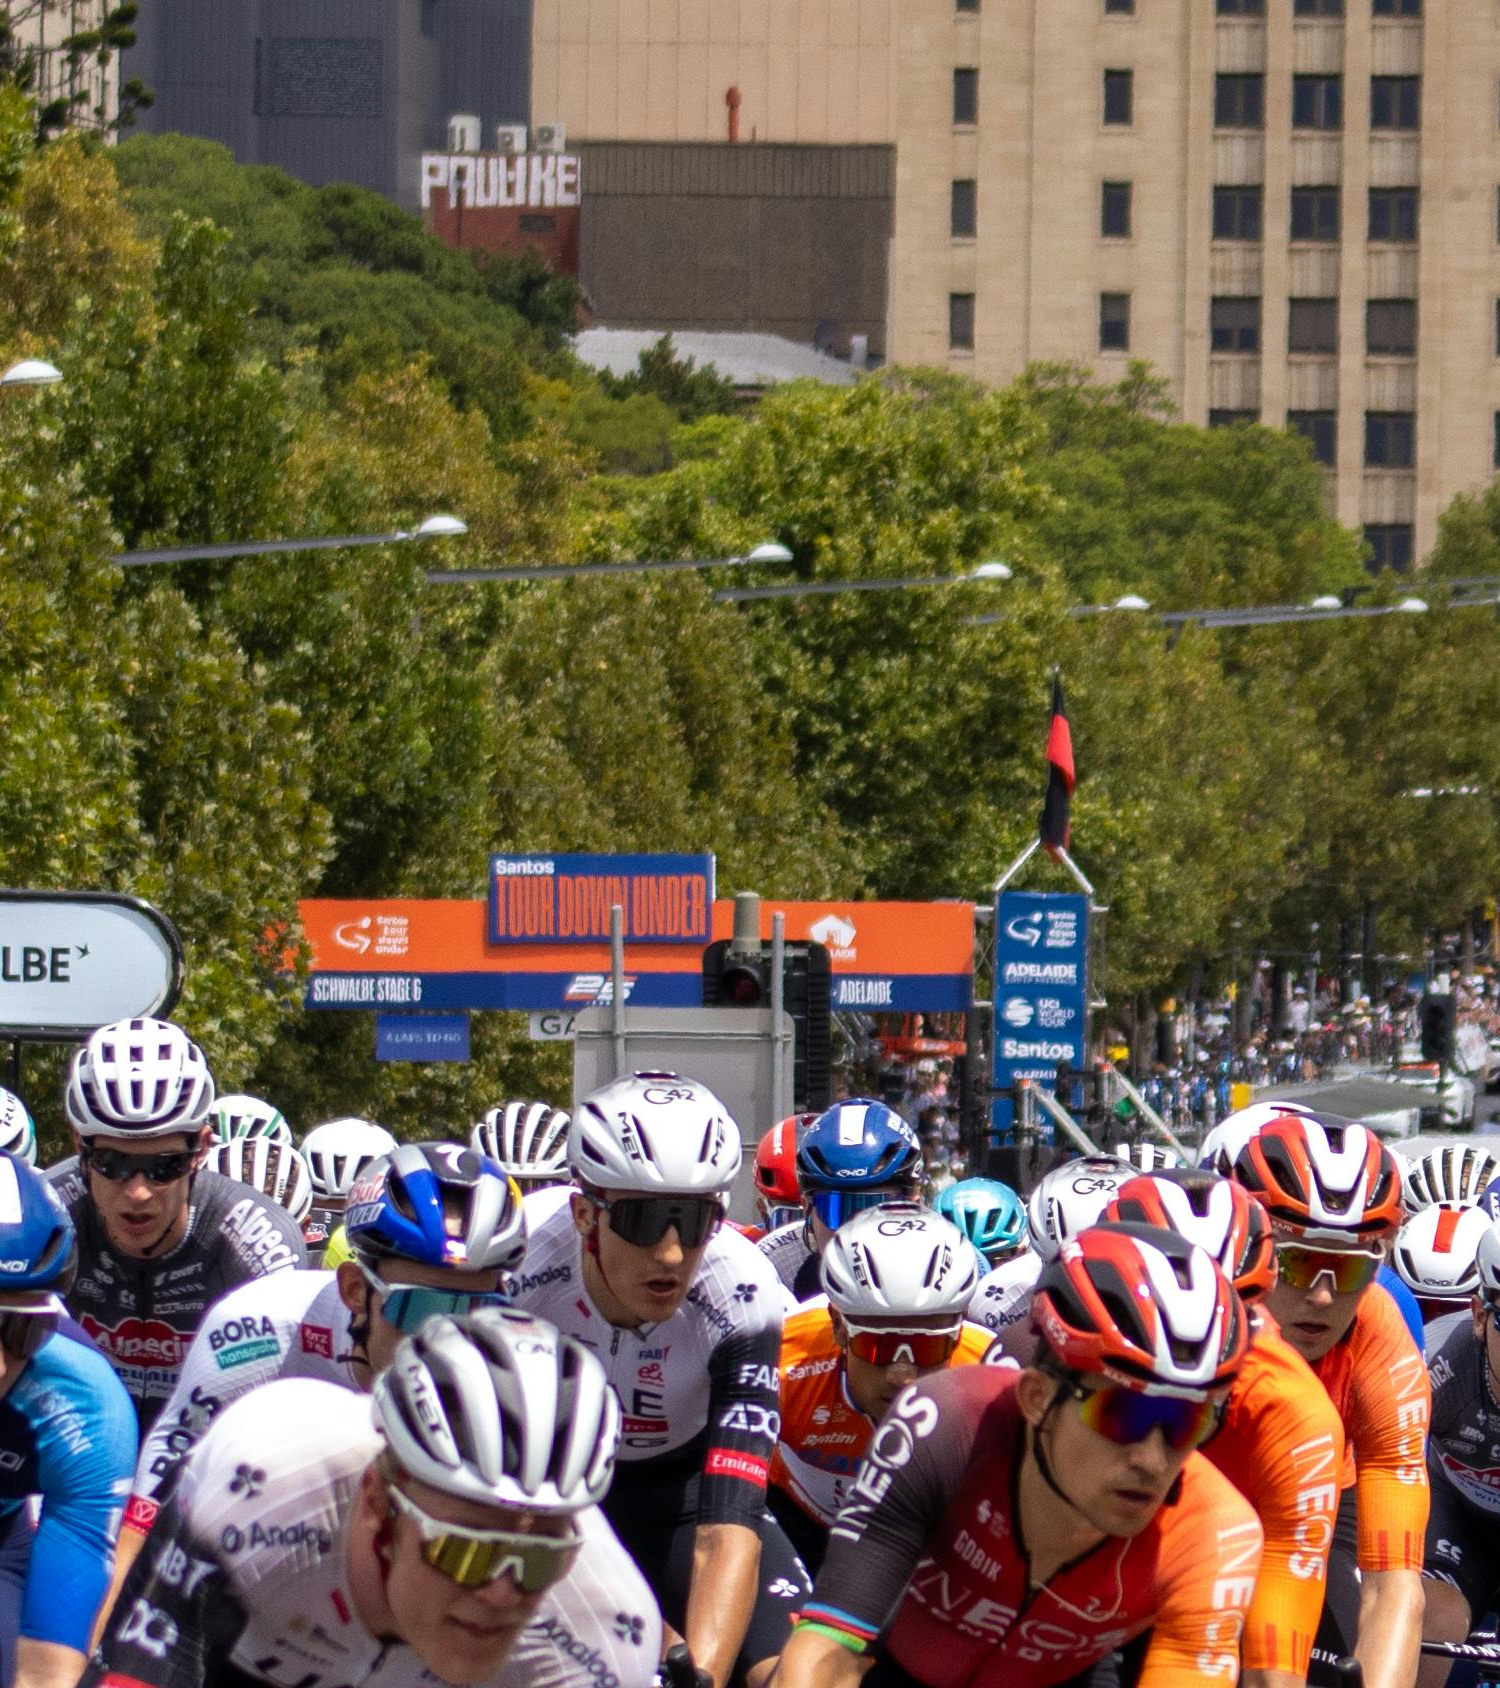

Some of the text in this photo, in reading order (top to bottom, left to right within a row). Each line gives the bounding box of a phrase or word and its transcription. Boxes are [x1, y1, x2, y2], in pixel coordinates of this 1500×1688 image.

[496, 859, 555, 875] Santos
[497, 876, 706, 936] TOUR DOWN UNDER
[1005, 963, 1078, 978] ADELAIDE
[314, 978, 422, 1002] SCHWALBE STAGE 6
[839, 979, 893, 1005] ADELAIDE
[1038, 1008, 1076, 1019] WORLD
[1038, 1018, 1067, 1028] TOUR
[1002, 1039, 1076, 1060] Santos
[1013, 1069, 1058, 1081] GARMI
[642, 1087, 697, 1106] G42
[618, 1111, 645, 1166] MET
[1071, 1177, 1118, 1196] G42
[224, 1198, 300, 1274] Alpeci
[877, 1219, 927, 1237] G42
[520, 1264, 572, 1293] Analog
[850, 1241, 873, 1290] MET
[97, 1332, 183, 1359] Alpeci
[208, 1315, 277, 1351] BORA
[787, 1357, 838, 1381] Santos
[150, 1387, 220, 1483] BOSS
[712, 1454, 768, 1481] Emirate
[831, 1384, 939, 1543] INEOS
[1288, 1432, 1338, 1582] INEOS
[250, 1520, 333, 1553] Analog
[953, 1530, 1004, 1583] GOBIK
[1198, 1522, 1263, 1682] INEOS
